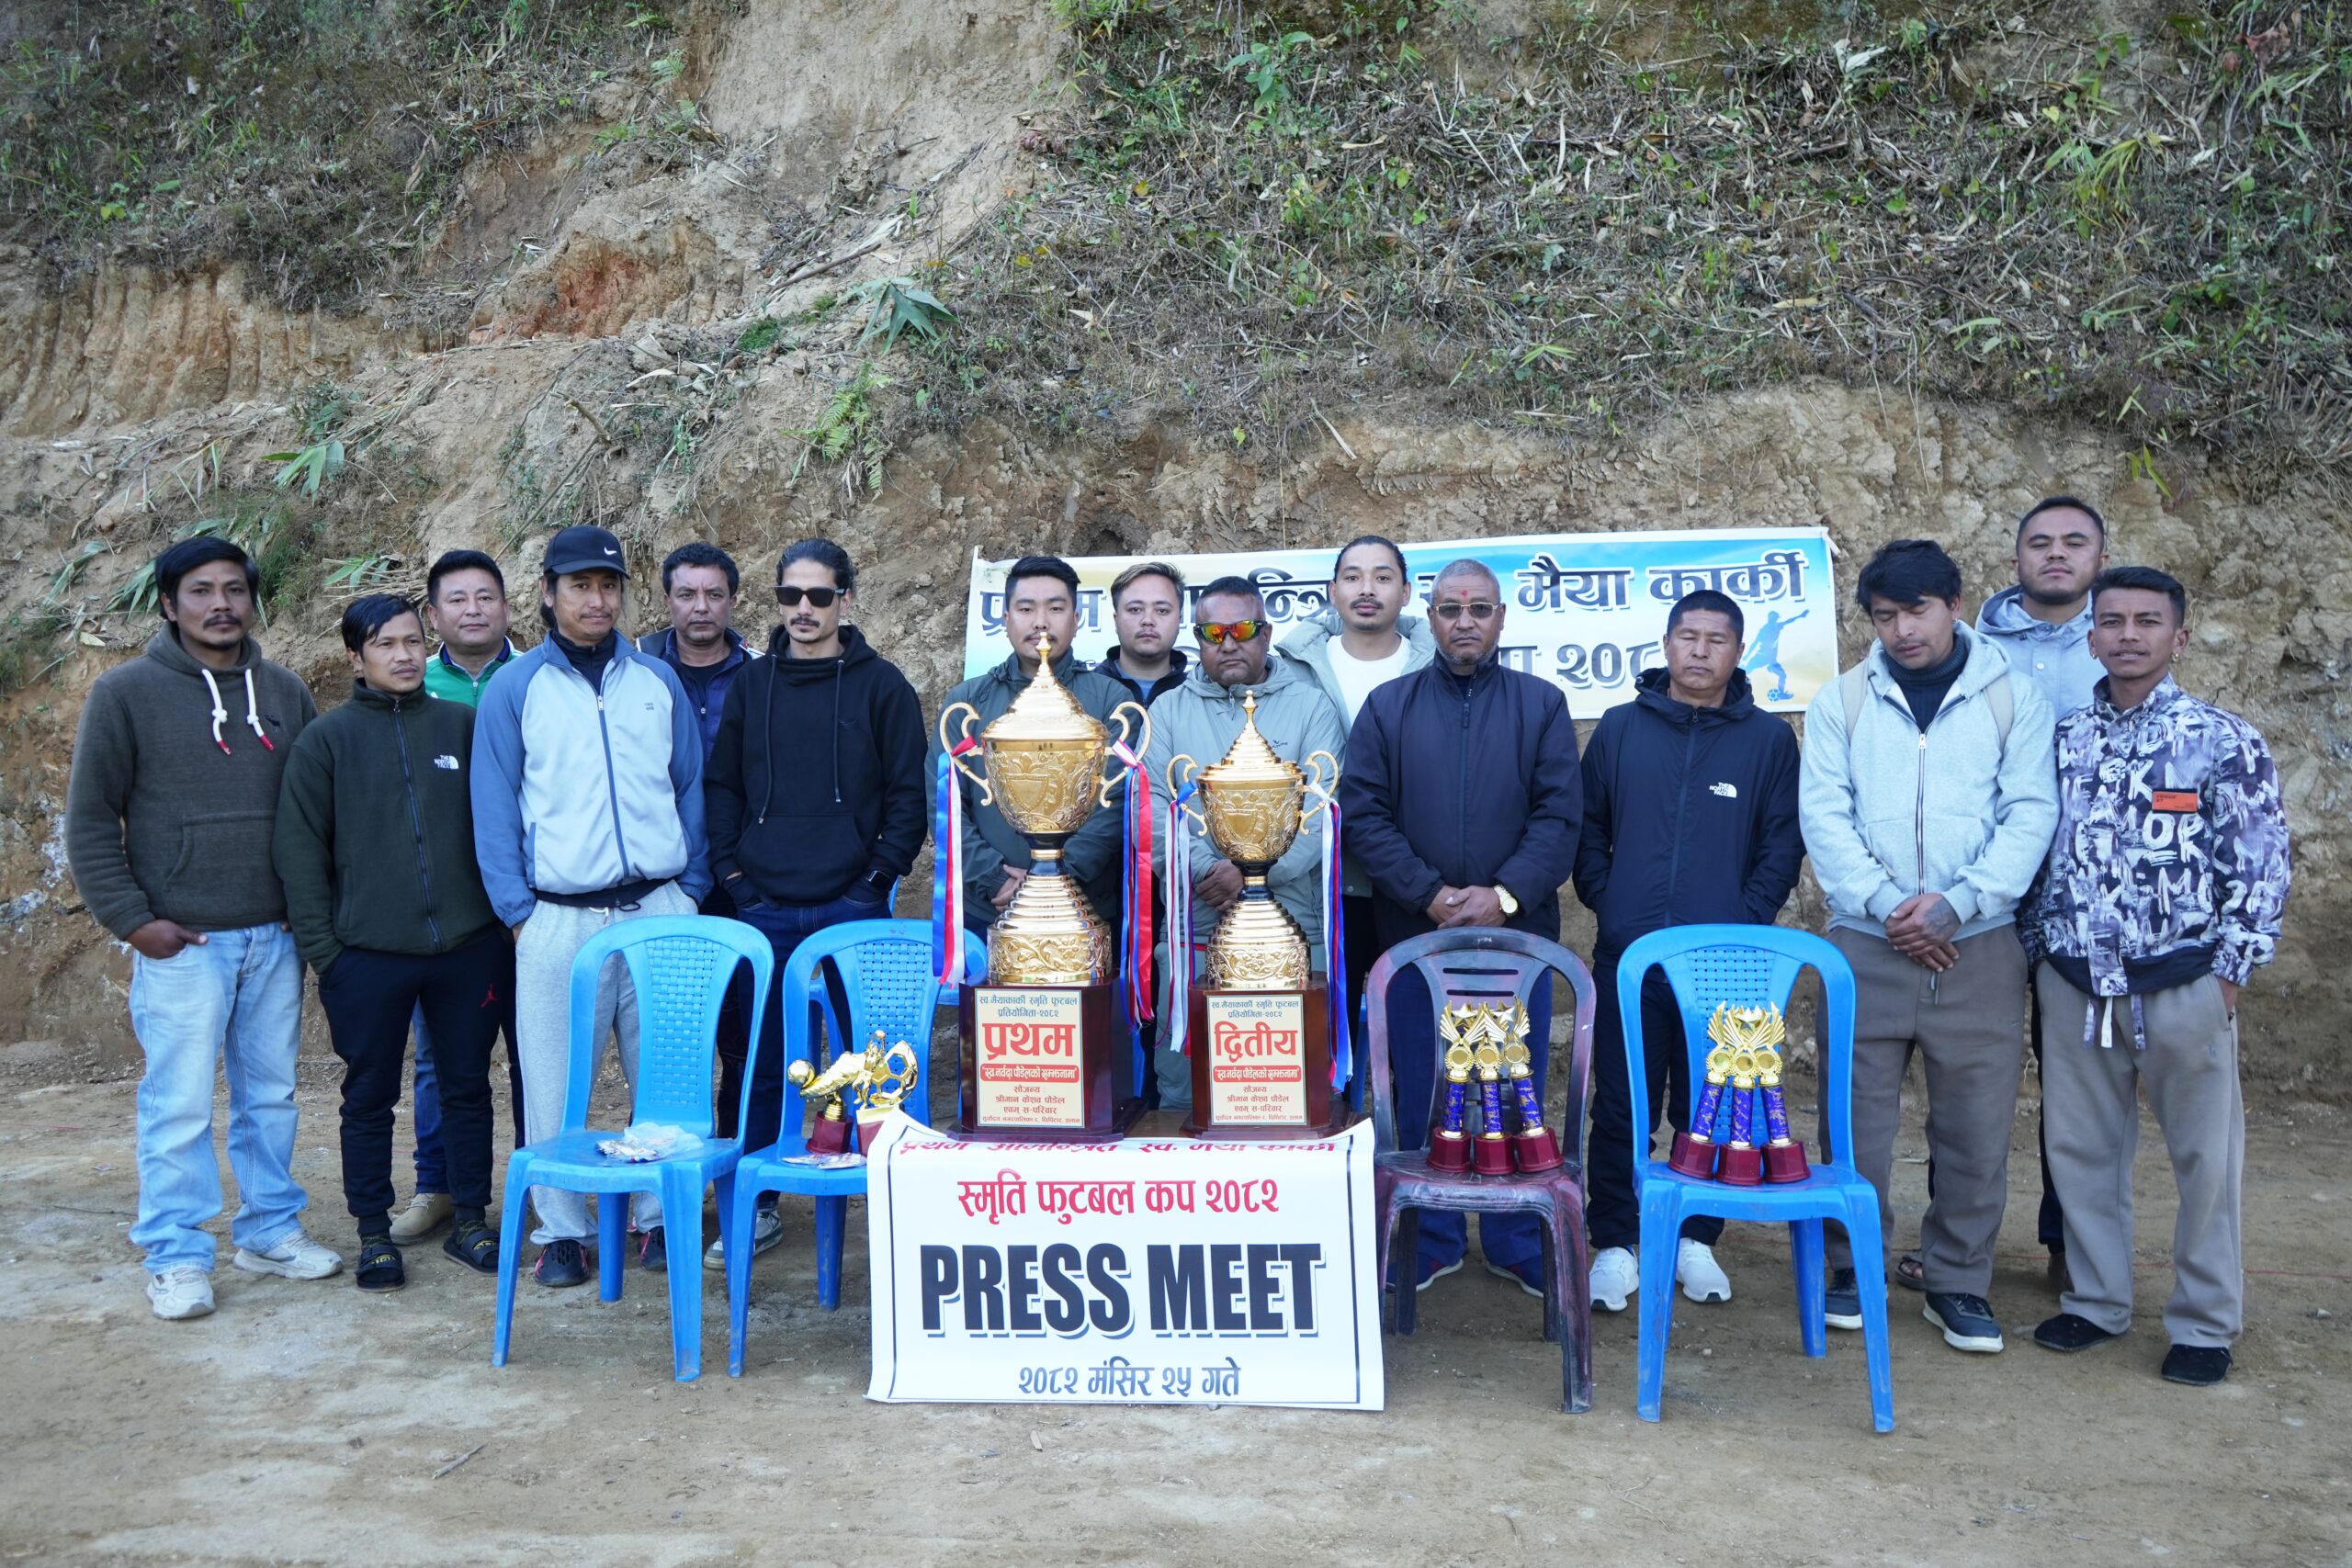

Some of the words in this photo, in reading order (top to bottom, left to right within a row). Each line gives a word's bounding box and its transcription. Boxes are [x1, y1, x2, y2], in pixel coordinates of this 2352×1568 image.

[980, 589, 1104, 632] प्रम
[1518, 555, 1631, 609] मैया
[1649, 551, 1805, 600] कार्की
[1556, 640, 1659, 686] २०८
[1028, 995, 1048, 1007] स्मृति
[982, 1022, 1076, 1061] प्रथम
[1214, 1021, 1298, 1064] द्वितीय
[1190, 1143, 1248, 1152] मया
[957, 1168, 1027, 1224] स्मृति
[1036, 1180, 1136, 1224] फुटबल
[1145, 1179, 1196, 1213] कप
[1205, 1179, 1280, 1213] २०८२
[920, 1243, 1135, 1339] PRESS
[1147, 1243, 1326, 1338] MEET
[1018, 1367, 1079, 1394] २०८२
[1088, 1355, 1155, 1397] मंसिर
[1161, 1367, 1192, 1398] २५
[1202, 1356, 1241, 1396] गते
